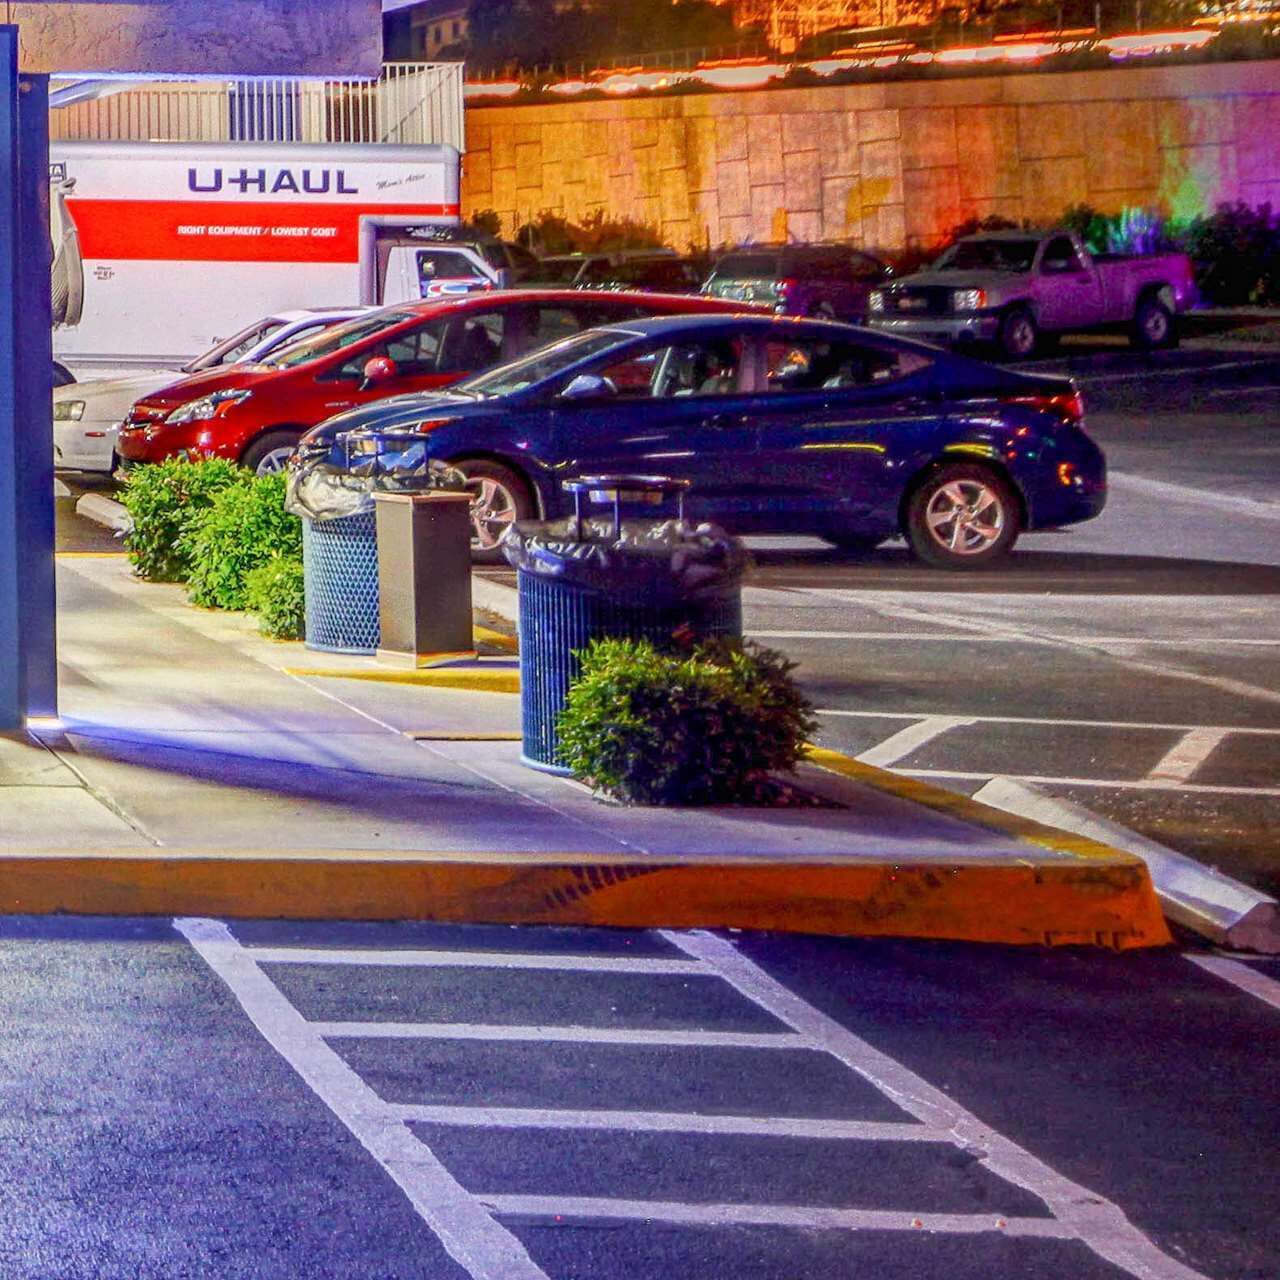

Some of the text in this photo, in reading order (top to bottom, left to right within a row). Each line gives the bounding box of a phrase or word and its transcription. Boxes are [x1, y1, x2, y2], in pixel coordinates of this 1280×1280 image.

[188, 168, 359, 195] U-HAUL
[177, 225, 205, 235] RIGHT
[207, 225, 262, 236] EQUIPMENT
[271, 226, 309, 237] LOWEST
[311, 226, 337, 237] COST
